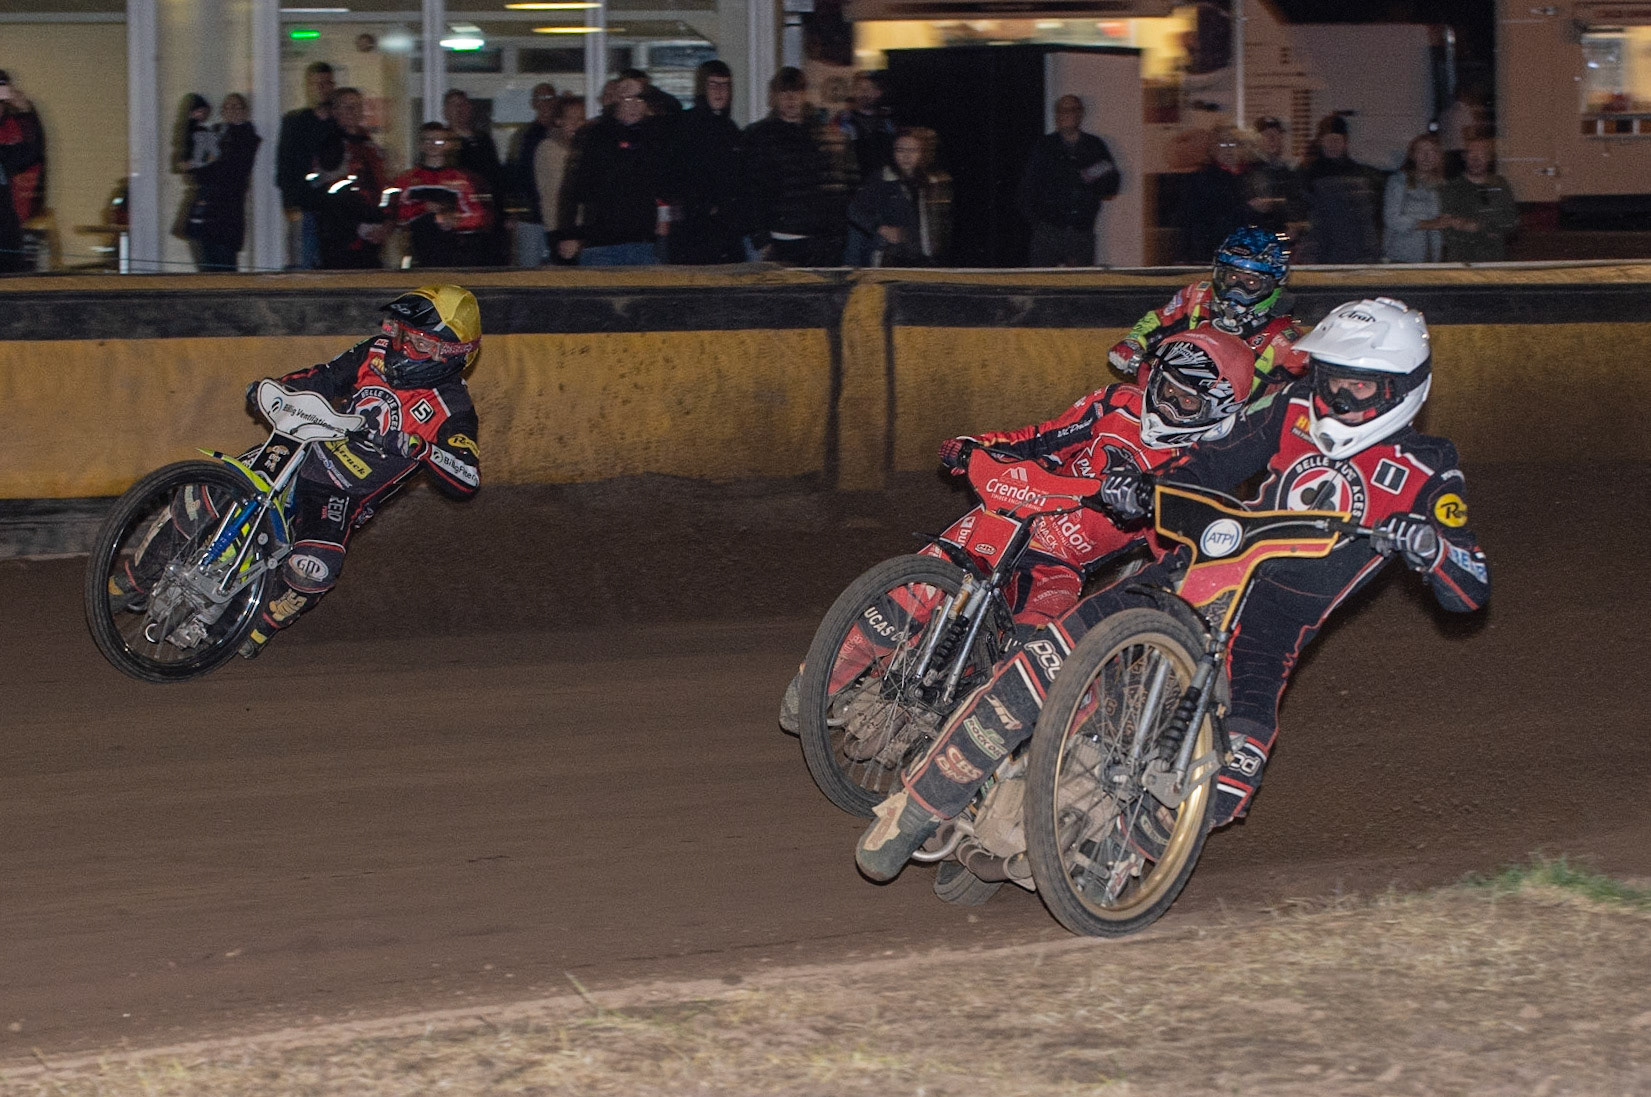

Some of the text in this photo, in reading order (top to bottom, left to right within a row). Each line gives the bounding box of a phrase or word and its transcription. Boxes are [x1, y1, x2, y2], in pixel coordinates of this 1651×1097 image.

[414, 402, 431, 418] 5
[985, 478, 1047, 507] Crendon
[1295, 456, 1365, 518] BELLE VUE ACES
[1207, 532, 1235, 545] ATPI
[863, 606, 895, 636] UCAS
[969, 720, 988, 745] ROCK
